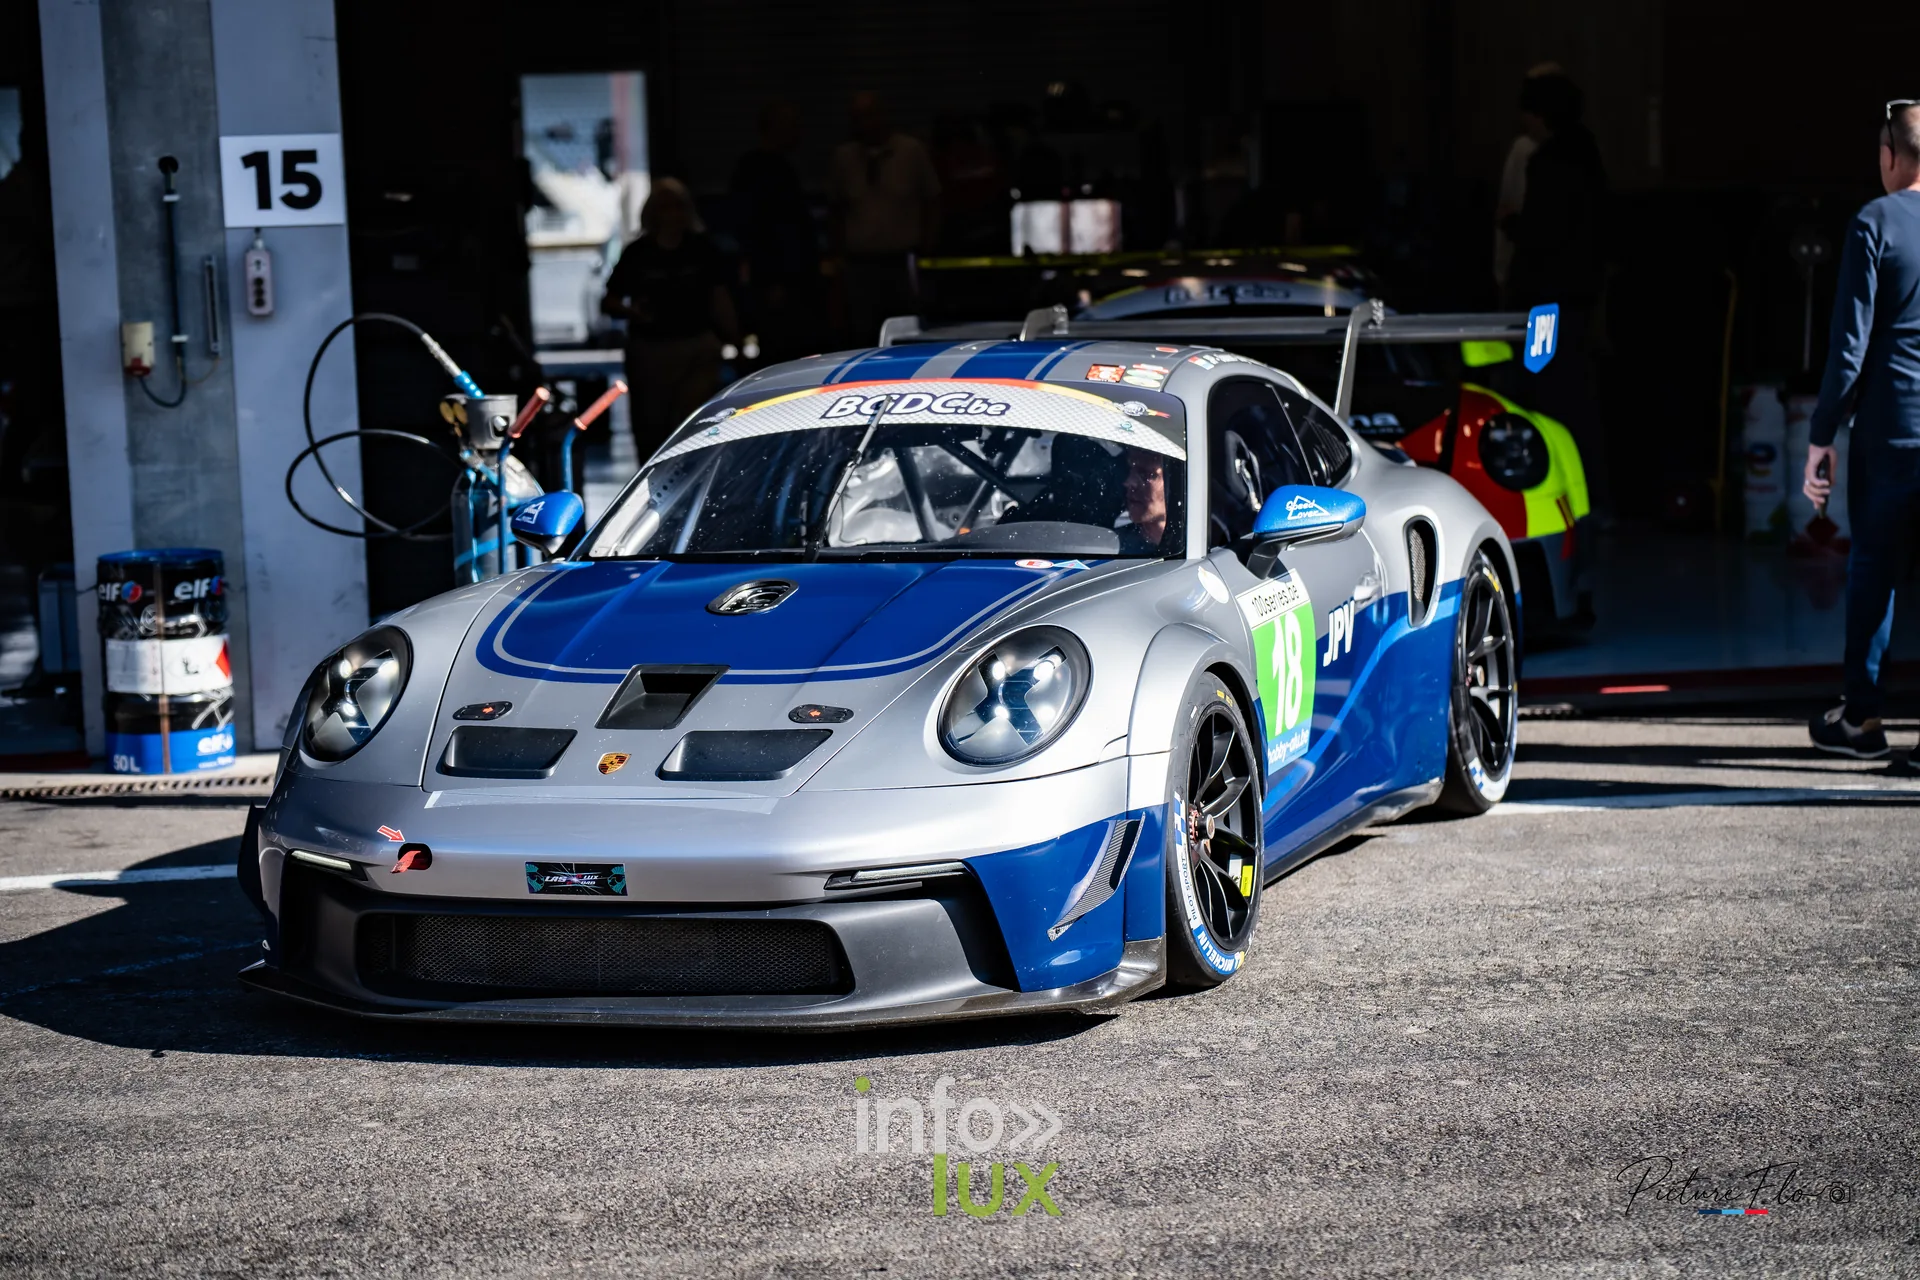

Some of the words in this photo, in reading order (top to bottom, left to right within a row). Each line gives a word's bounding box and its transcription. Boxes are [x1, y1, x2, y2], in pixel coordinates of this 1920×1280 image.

[240, 149, 322, 210] 15
[1530, 313, 1556, 357] JPV
[99, 581, 120, 600] elf
[174, 577, 210, 600] elf
[1251, 584, 1300, 618] 100series.be
[1323, 600, 1355, 667] JPV
[1272, 611, 1303, 736] 18
[1181, 857, 1191, 891] SPORT
[1187, 894, 1198, 921] PILOT
[1197, 930, 1235, 972] MICHELIN
